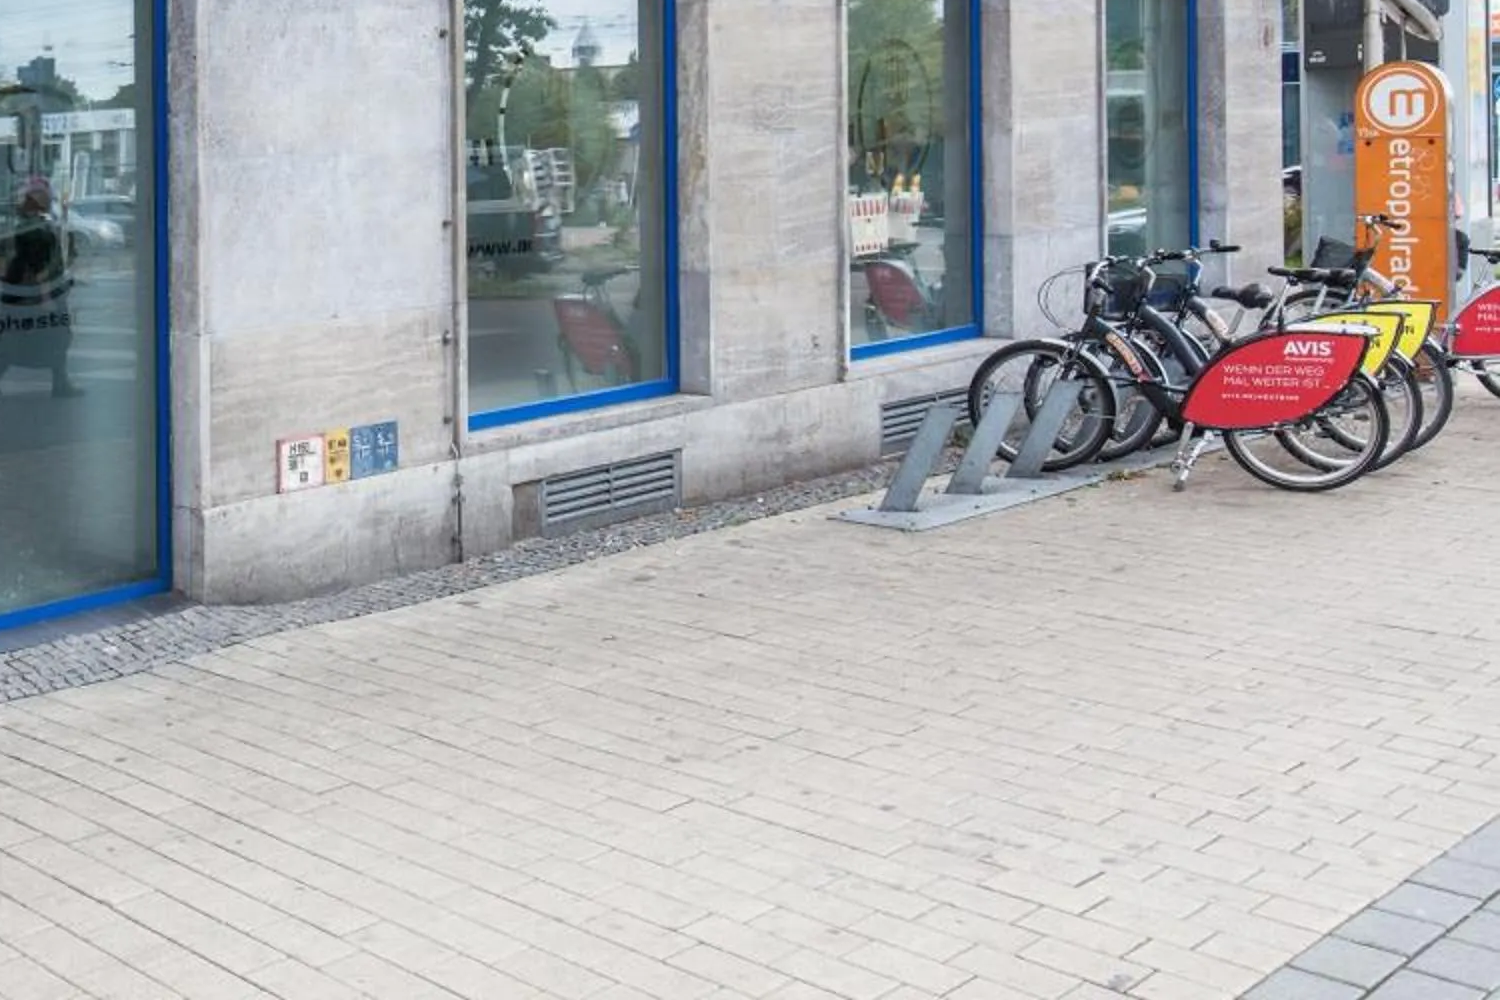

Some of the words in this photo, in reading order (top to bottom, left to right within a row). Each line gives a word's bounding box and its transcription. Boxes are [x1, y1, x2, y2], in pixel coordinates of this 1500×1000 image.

[1283, 341, 1332, 356] AVIS
[1222, 364, 1262, 375] WENN
[1265, 365, 1292, 375] DER
[1294, 366, 1325, 377] WEG
[1223, 375, 1250, 386] MAL
[1252, 377, 1300, 388] WEITER
